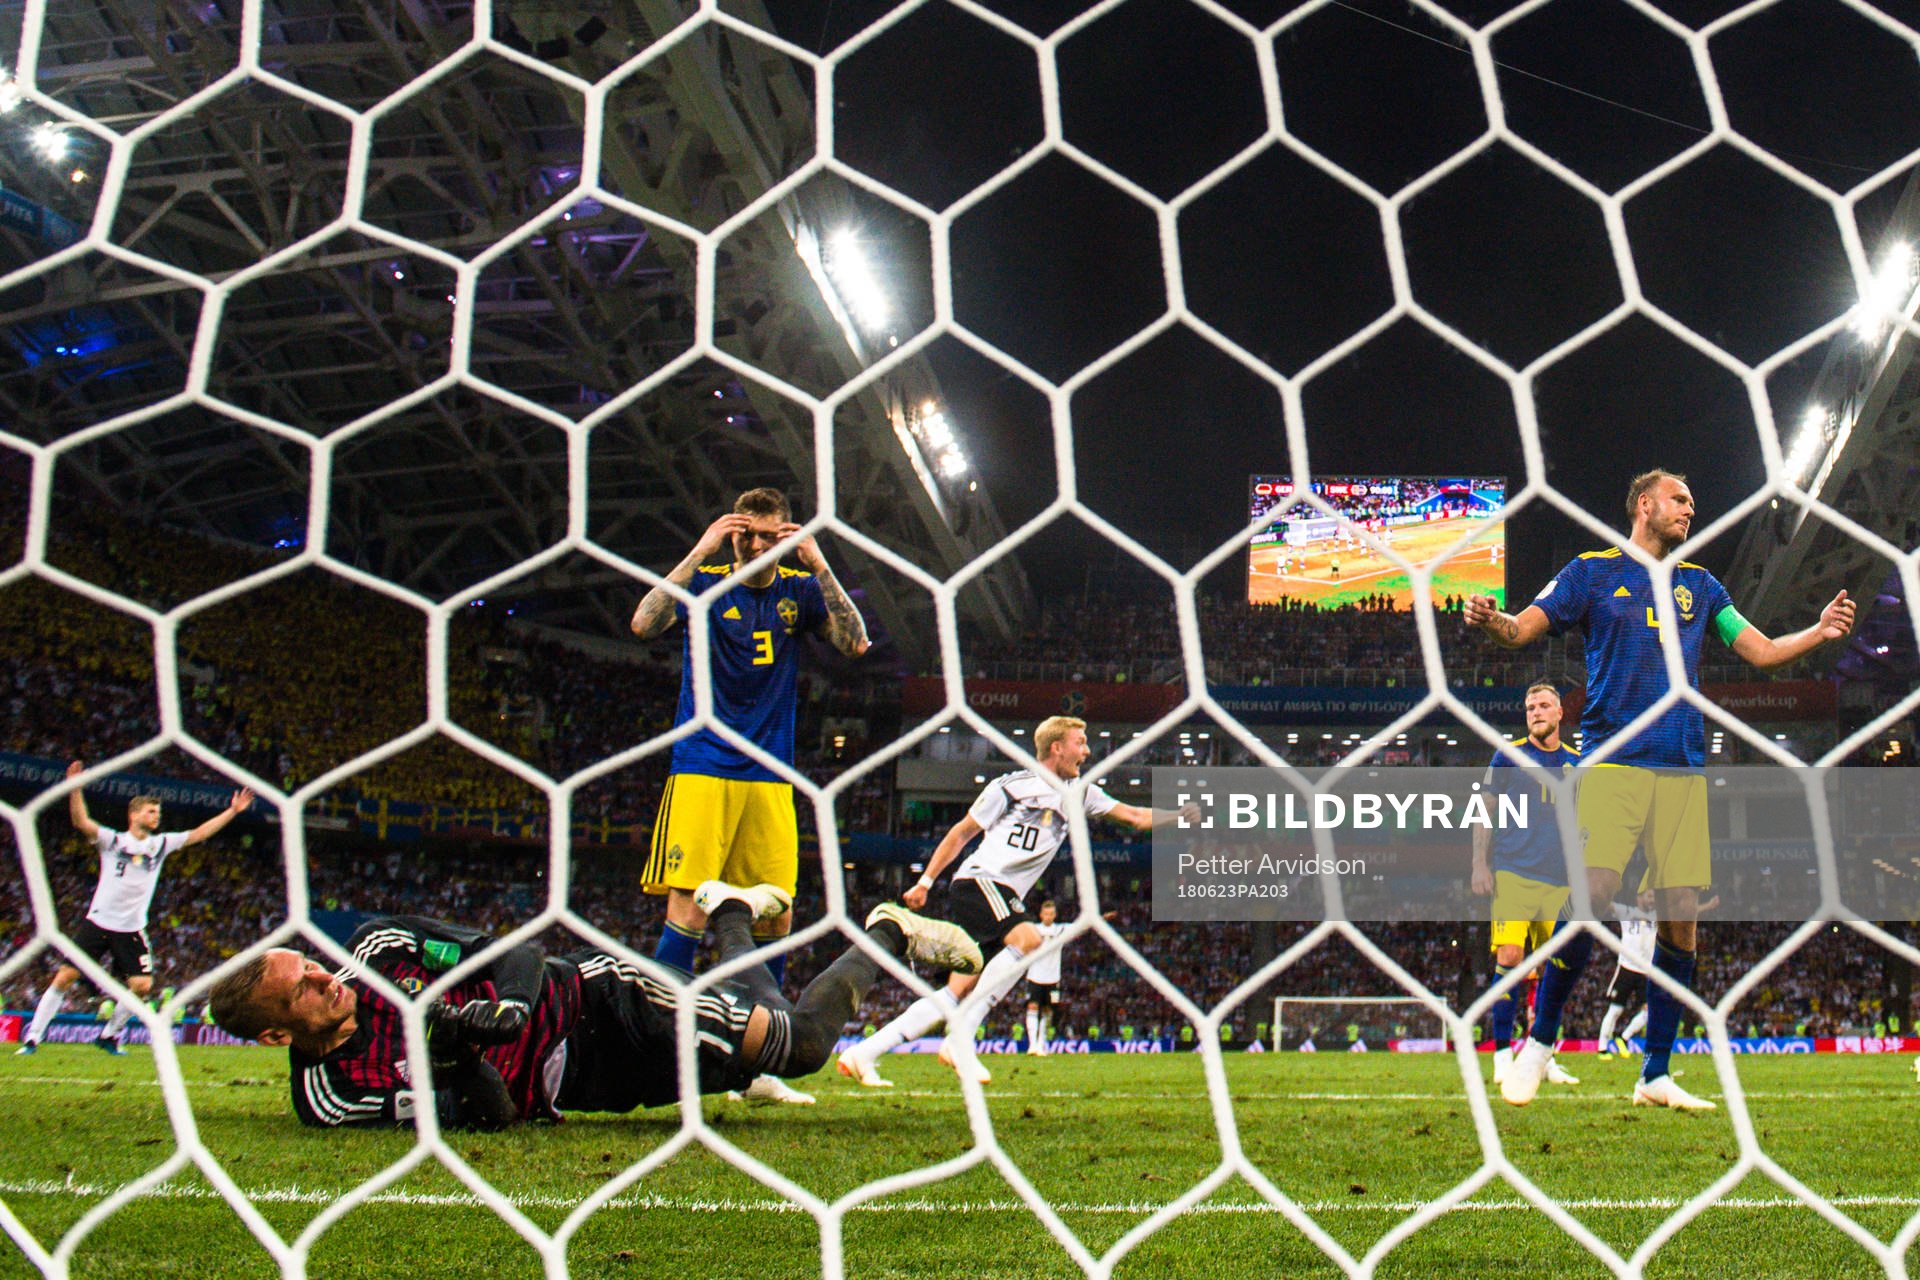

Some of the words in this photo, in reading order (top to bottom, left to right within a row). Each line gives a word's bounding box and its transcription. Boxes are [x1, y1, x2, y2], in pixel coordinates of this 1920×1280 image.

[752, 630, 774, 665] 3
[967, 692, 1019, 707] СОЧИ
[1326, 701, 1346, 711] ПО
[1007, 823, 1039, 851] 20
[1724, 848, 1750, 861] CUP
[1756, 848, 1809, 861] RUSSIA
[115, 861, 126, 878] 9
[973, 1040, 1018, 1053] VISA
[1044, 1040, 1089, 1053] VISA
[1112, 1040, 1162, 1053] VISA
